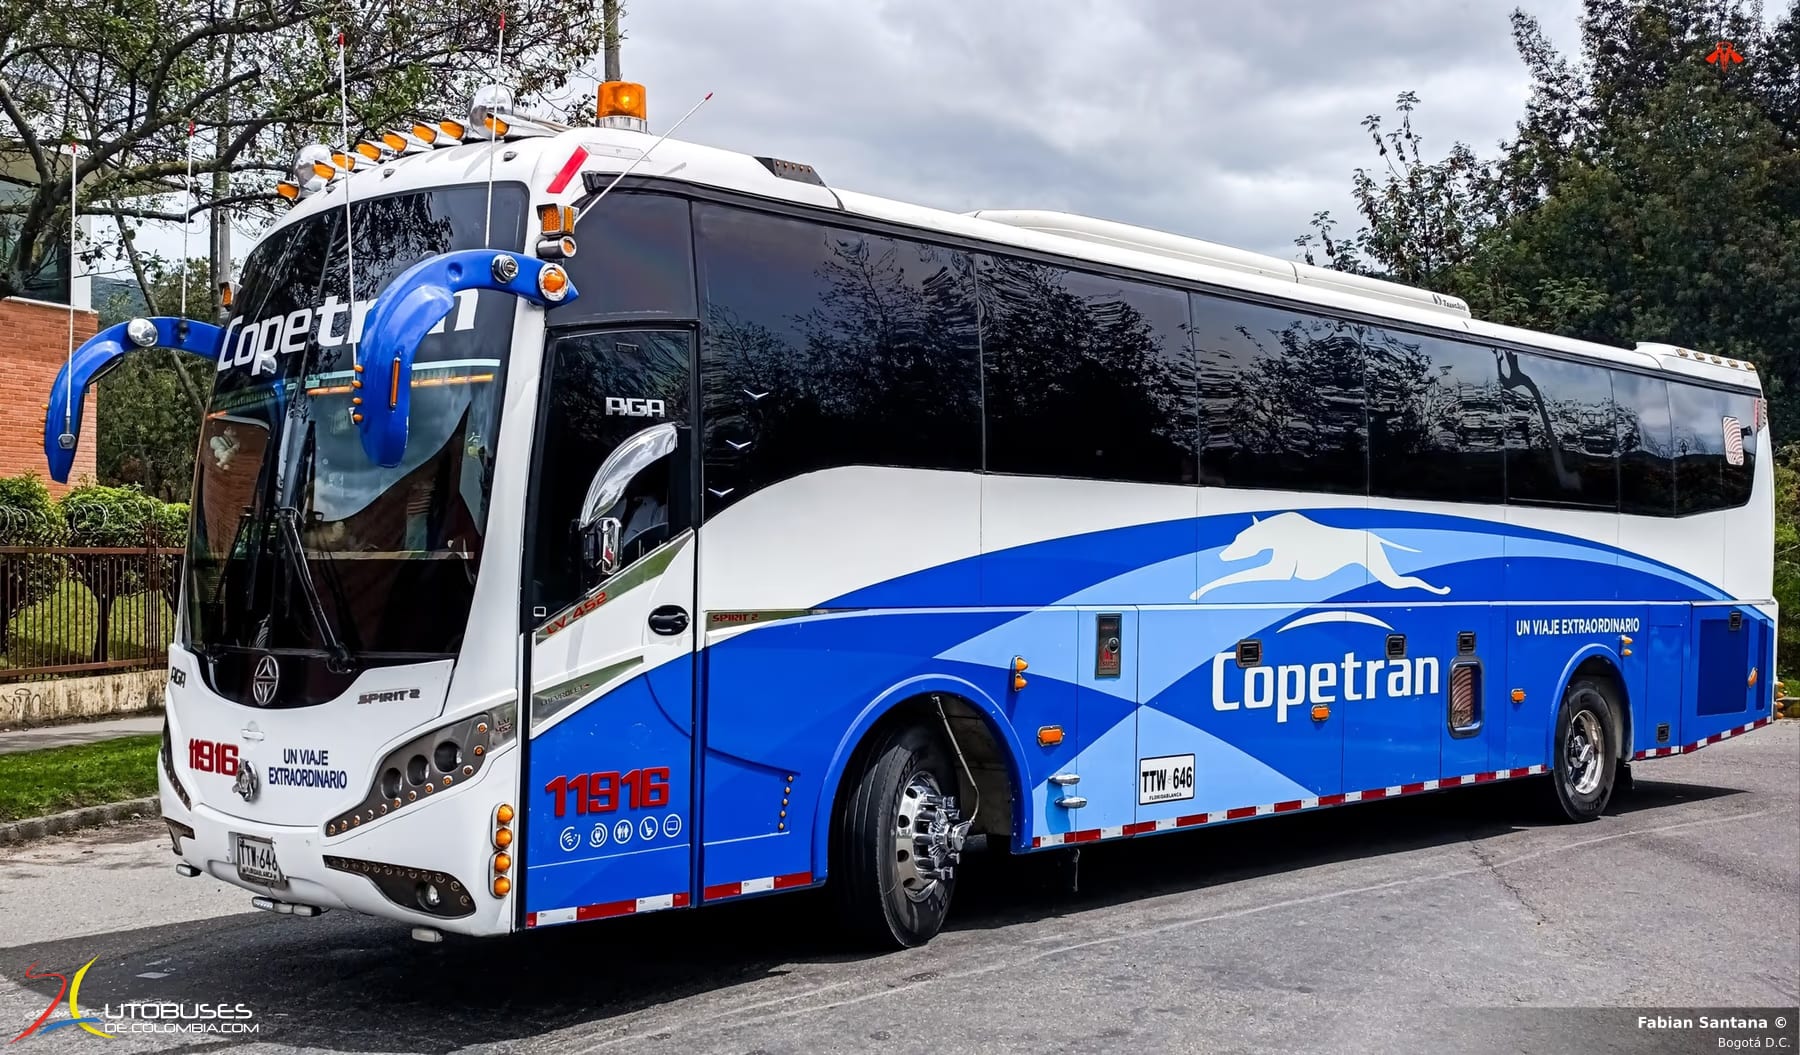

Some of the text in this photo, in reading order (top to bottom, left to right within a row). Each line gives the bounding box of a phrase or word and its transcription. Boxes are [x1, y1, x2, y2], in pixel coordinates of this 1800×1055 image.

[217, 288, 479, 377] Copetrn
[605, 396, 666, 418] AGA
[546, 591, 608, 635] LV 452
[712, 613, 759, 622] SPIRIT 2
[1516, 618, 1640, 636] UN VIAJE EXTRAORDINARIO
[170, 665, 187, 688] AGA
[1212, 652, 1440, 723] Copetran
[357, 688, 421, 705] SPIRIT 2
[188, 738, 239, 776] 11916
[283, 748, 329, 766] UN VIAJE
[268, 767, 348, 789] EXTRAORDINARIO
[1142, 766, 1193, 793] TTW 646
[545, 766, 671, 817] 11916
